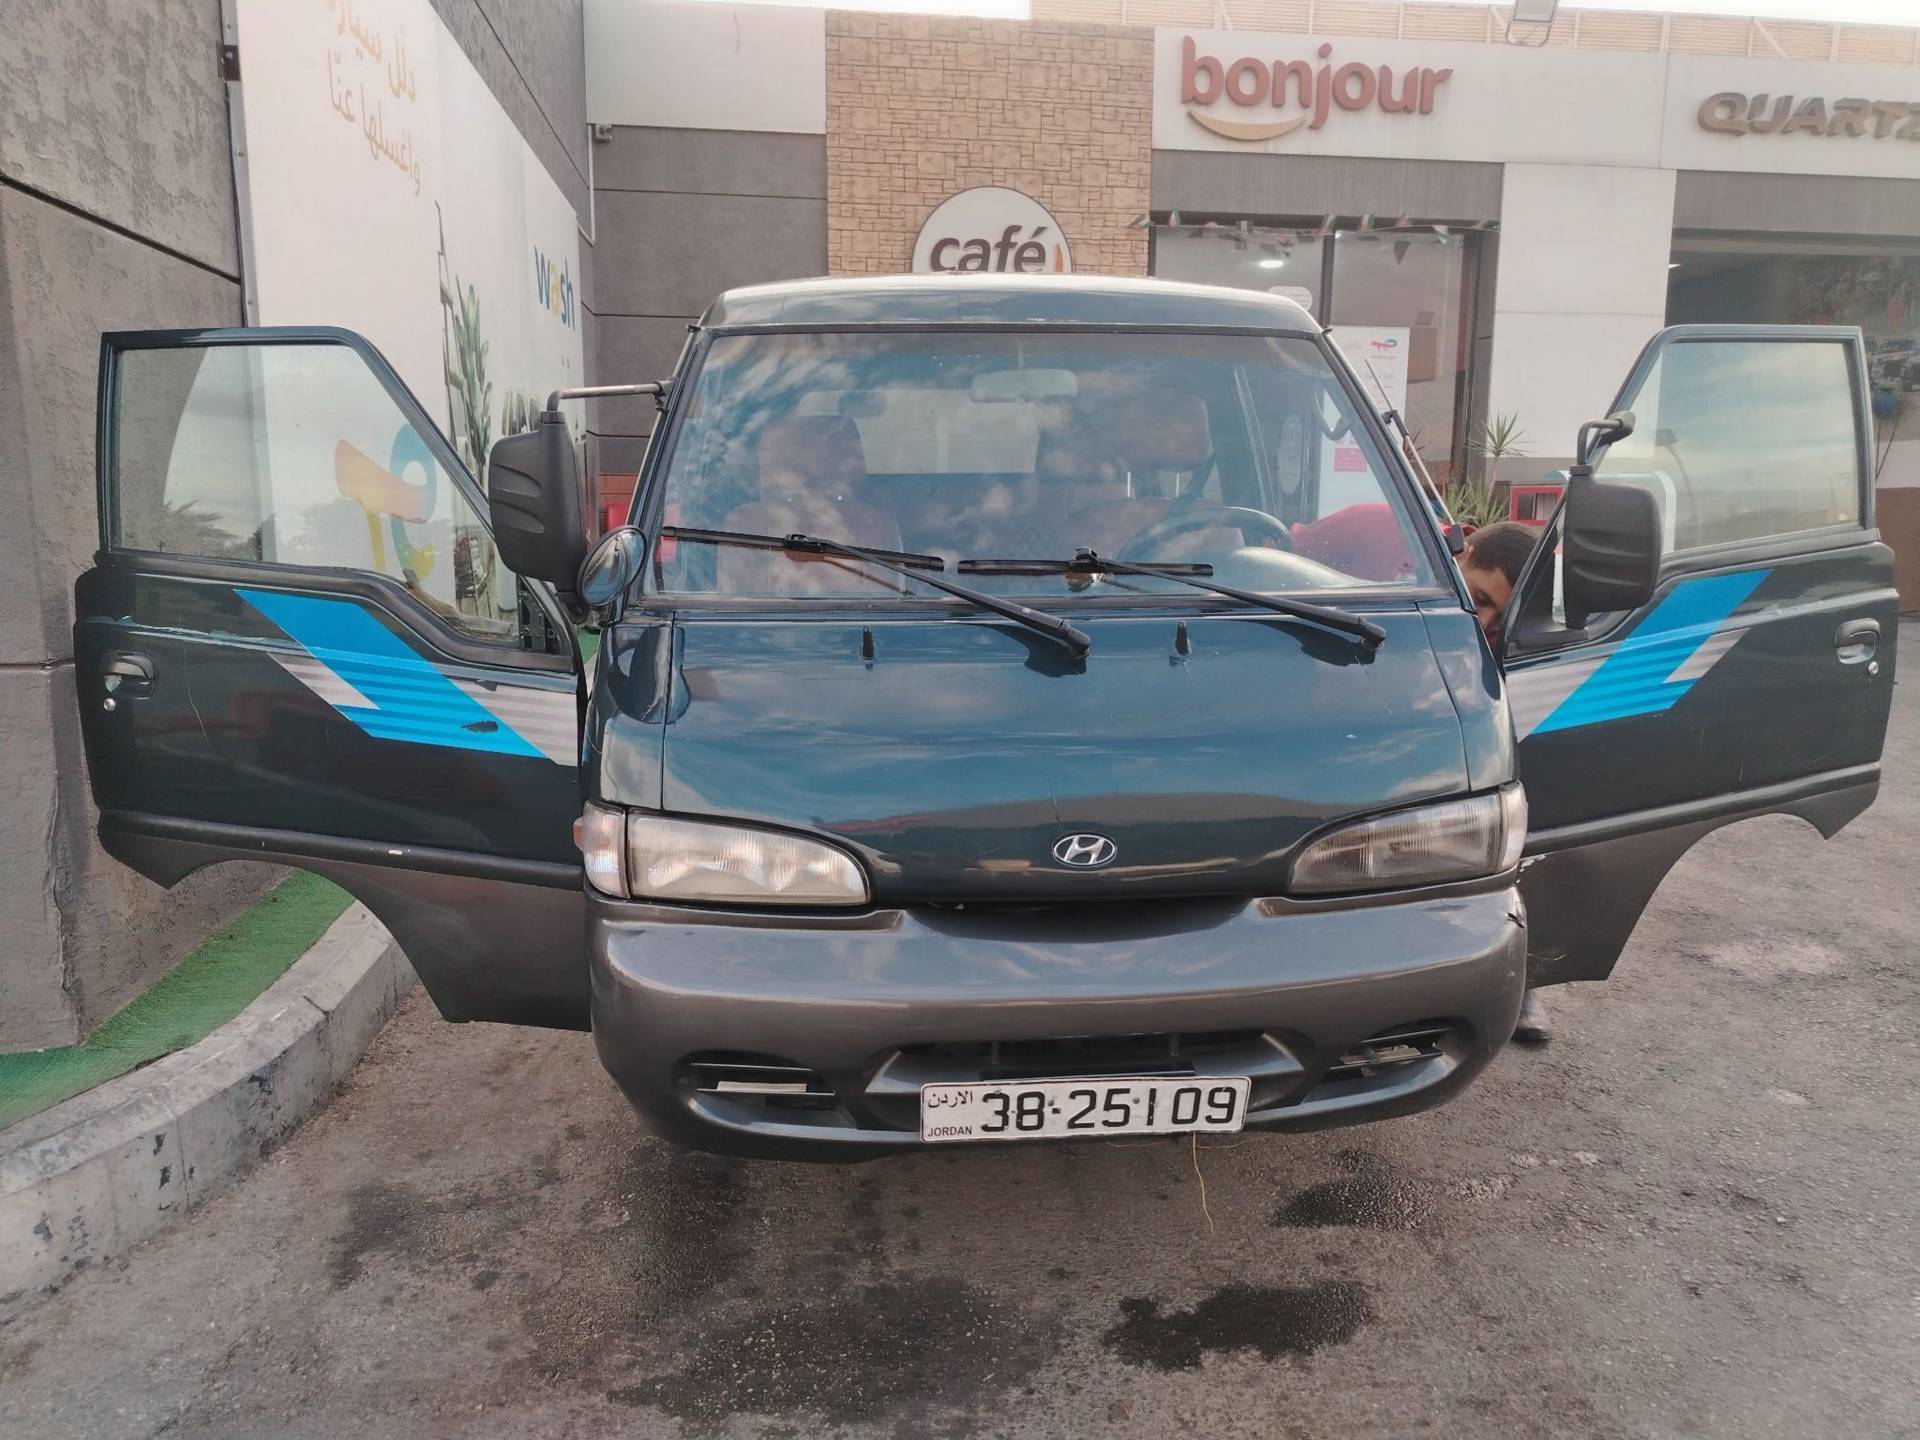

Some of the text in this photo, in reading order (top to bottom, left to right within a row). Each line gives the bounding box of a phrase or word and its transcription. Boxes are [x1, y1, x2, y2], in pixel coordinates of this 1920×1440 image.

[1181, 35, 1454, 130] bonjour
[930, 225, 1048, 272] café
[927, 1125, 973, 1137] JORDAN
